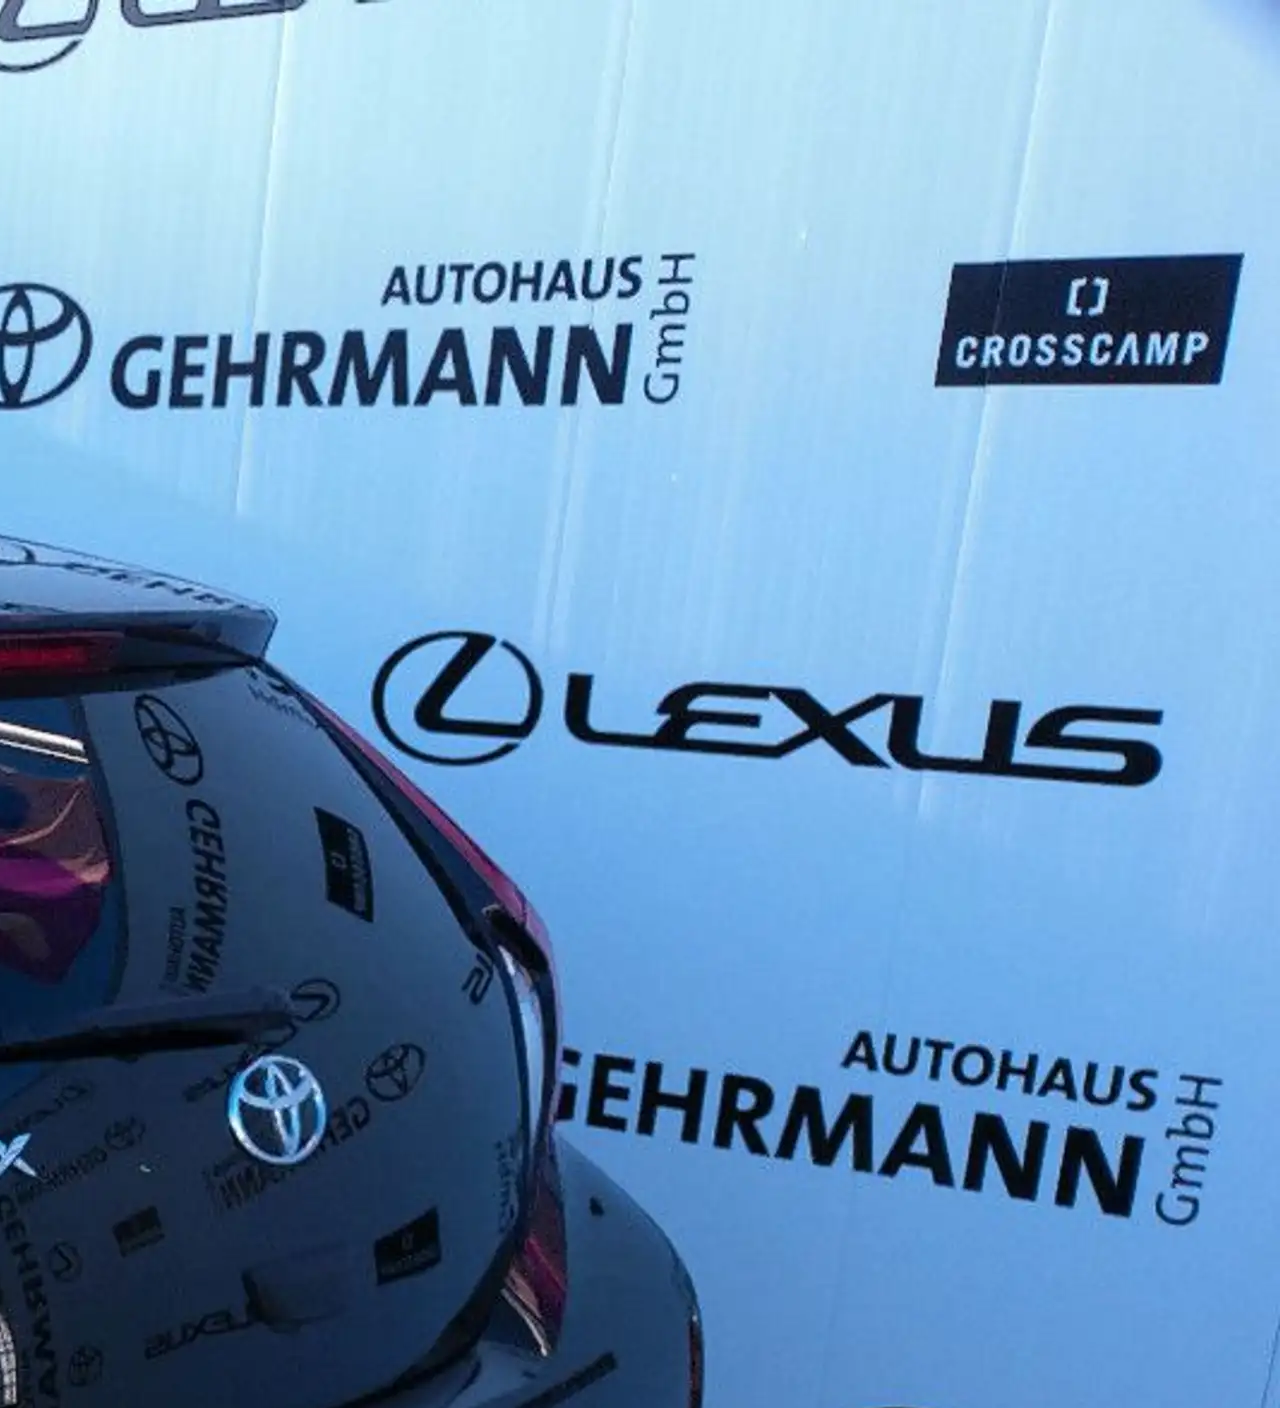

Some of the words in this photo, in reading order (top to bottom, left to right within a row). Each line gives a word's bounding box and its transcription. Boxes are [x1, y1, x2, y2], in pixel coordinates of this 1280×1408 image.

[381, 255, 643, 306] AUTOHAUS
[110, 322, 634, 409] GEHRMANN
[643, 252, 696, 405] GmbH
[955, 331, 1210, 369] CROSSCAMP
[564, 672, 1164, 787] LEXUS
[840, 1030, 1159, 1112] AUTOHAUS
[1155, 1072, 1224, 1227] GmbH
